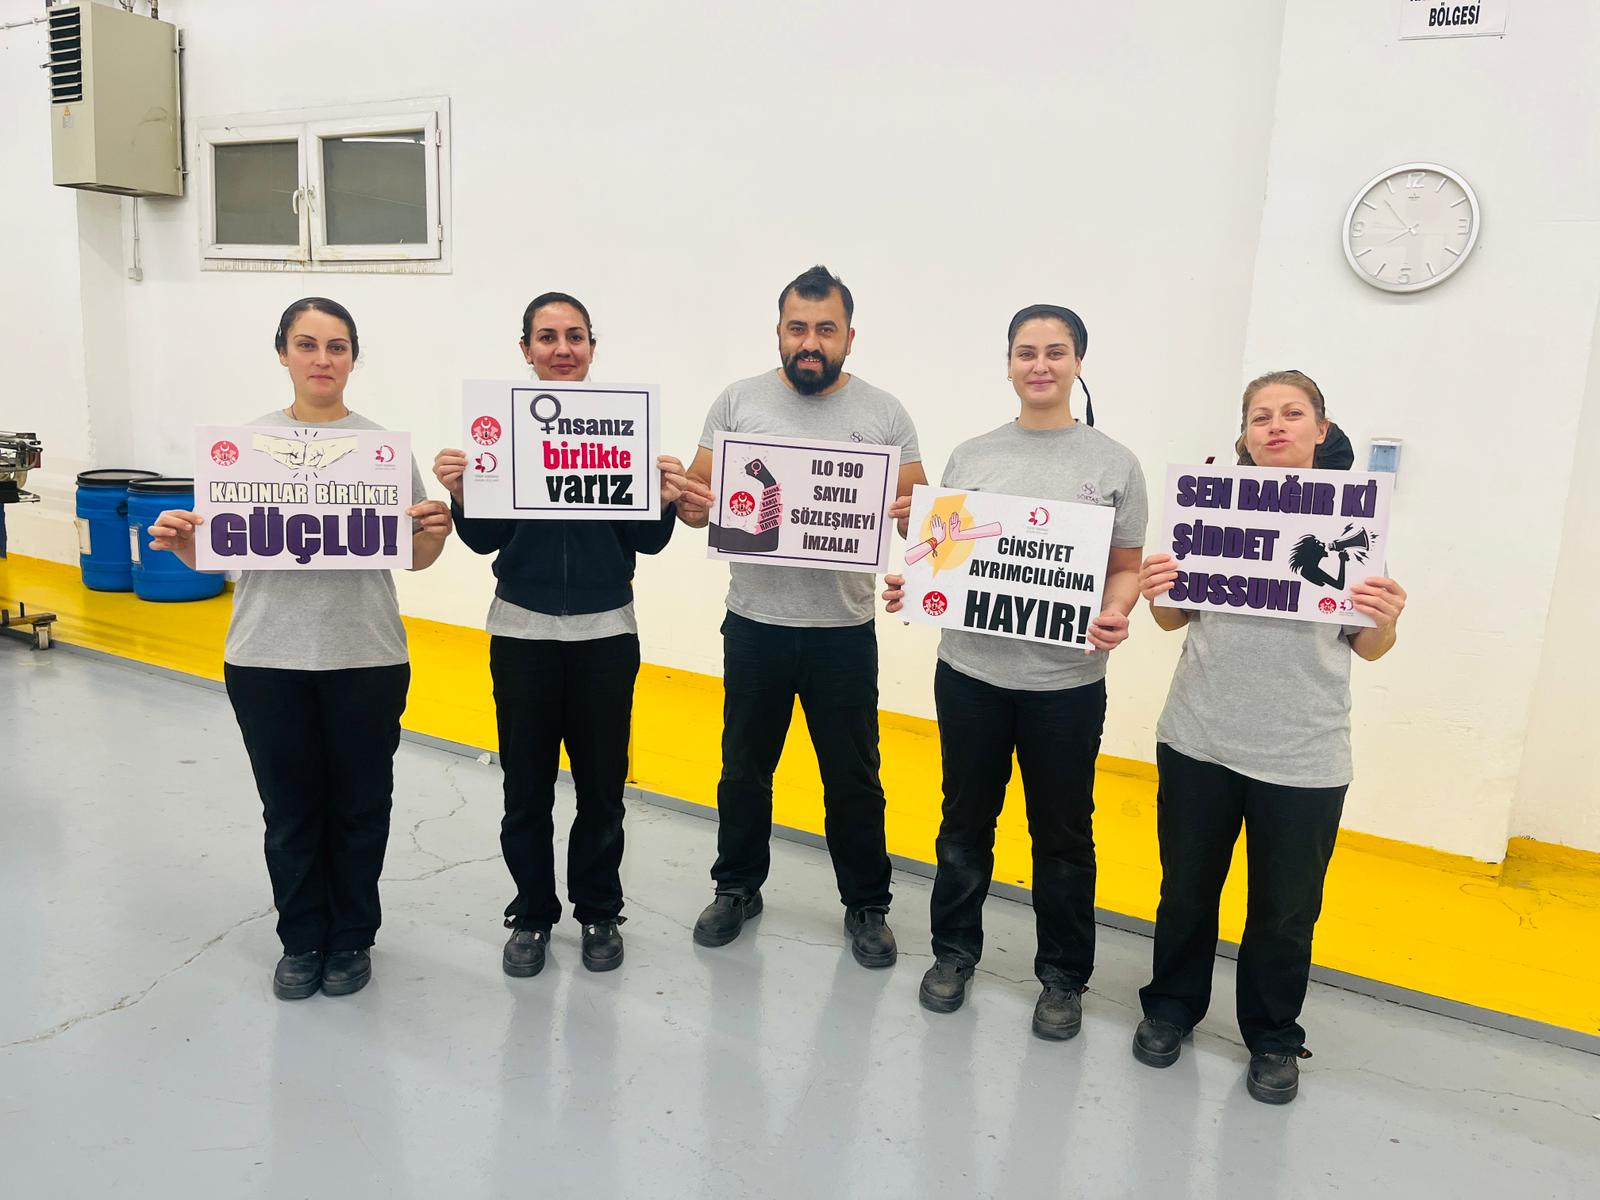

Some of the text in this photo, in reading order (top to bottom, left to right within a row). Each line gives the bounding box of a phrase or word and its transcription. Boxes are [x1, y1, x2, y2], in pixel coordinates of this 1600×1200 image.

[1429, 0, 1480, 26] BÖLGESİ
[542, 440, 631, 470] birlikte
[811, 459, 864, 479] ILO 190
[210, 481, 398, 505] KADINLAR BİRLİKTE
[545, 474, 633, 506] varız
[813, 485, 858, 504] SAYILI
[1176, 475, 1378, 518] SEN BAĞIR Kİ
[790, 508, 876, 531] SÖZLEŞMEYİ
[210, 506, 399, 564] GÜÇLÜ!
[802, 532, 859, 553] İMZALA!
[997, 536, 1074, 563] CİNSİYET
[1172, 519, 1280, 561] ŞİDDET
[968, 559, 1095, 593] AYRIMCILIĞINA
[1168, 570, 1302, 613] SUSSUN!
[963, 589, 1092, 645] HAYIR!
